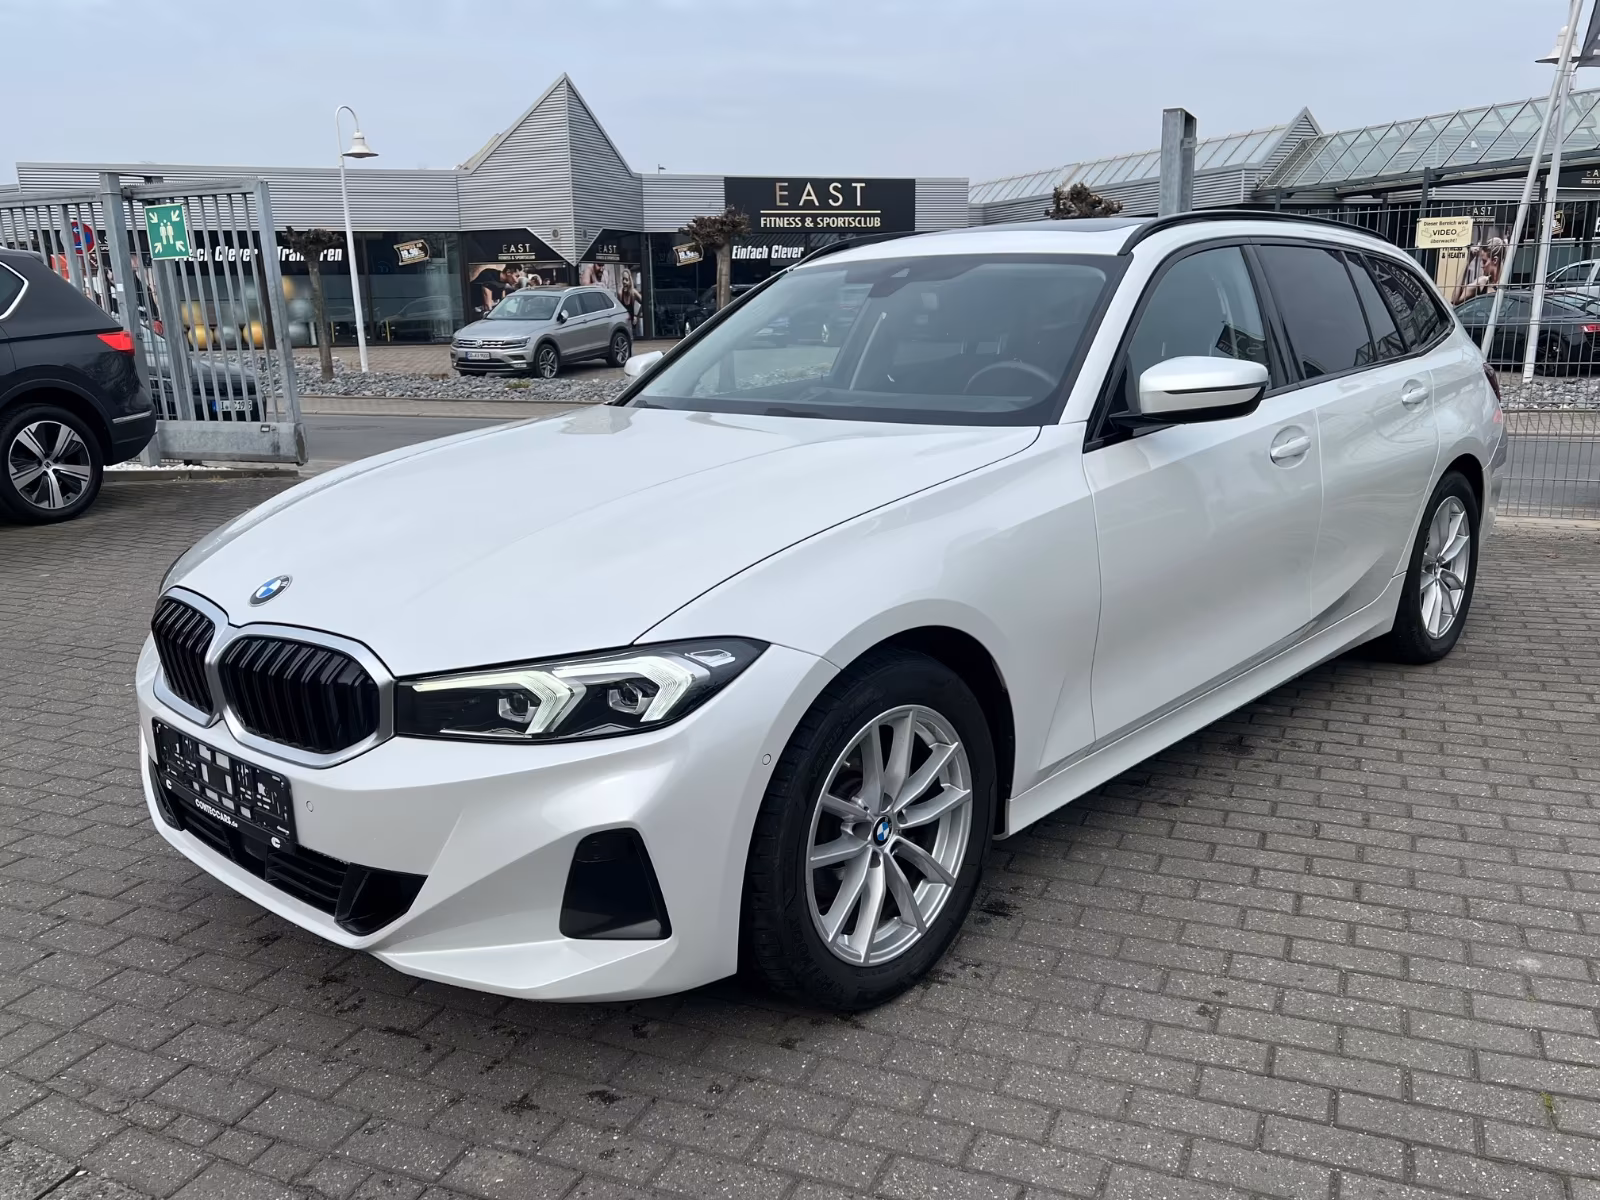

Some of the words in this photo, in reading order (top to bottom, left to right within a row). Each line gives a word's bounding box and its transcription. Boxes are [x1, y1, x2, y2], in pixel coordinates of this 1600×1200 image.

[775, 182, 866, 207] EAST
[1466, 206, 1492, 215] EAST
[760, 216, 802, 228] FITNESS
[804, 216, 814, 228] &
[817, 216, 881, 228] SPORTSCLUB
[1432, 228, 1457, 236] VIDEO
[502, 243, 530, 253] EAST
[599, 245, 617, 254] EAST
[731, 245, 769, 259] Einfach
[771, 244, 805, 259] Clever
